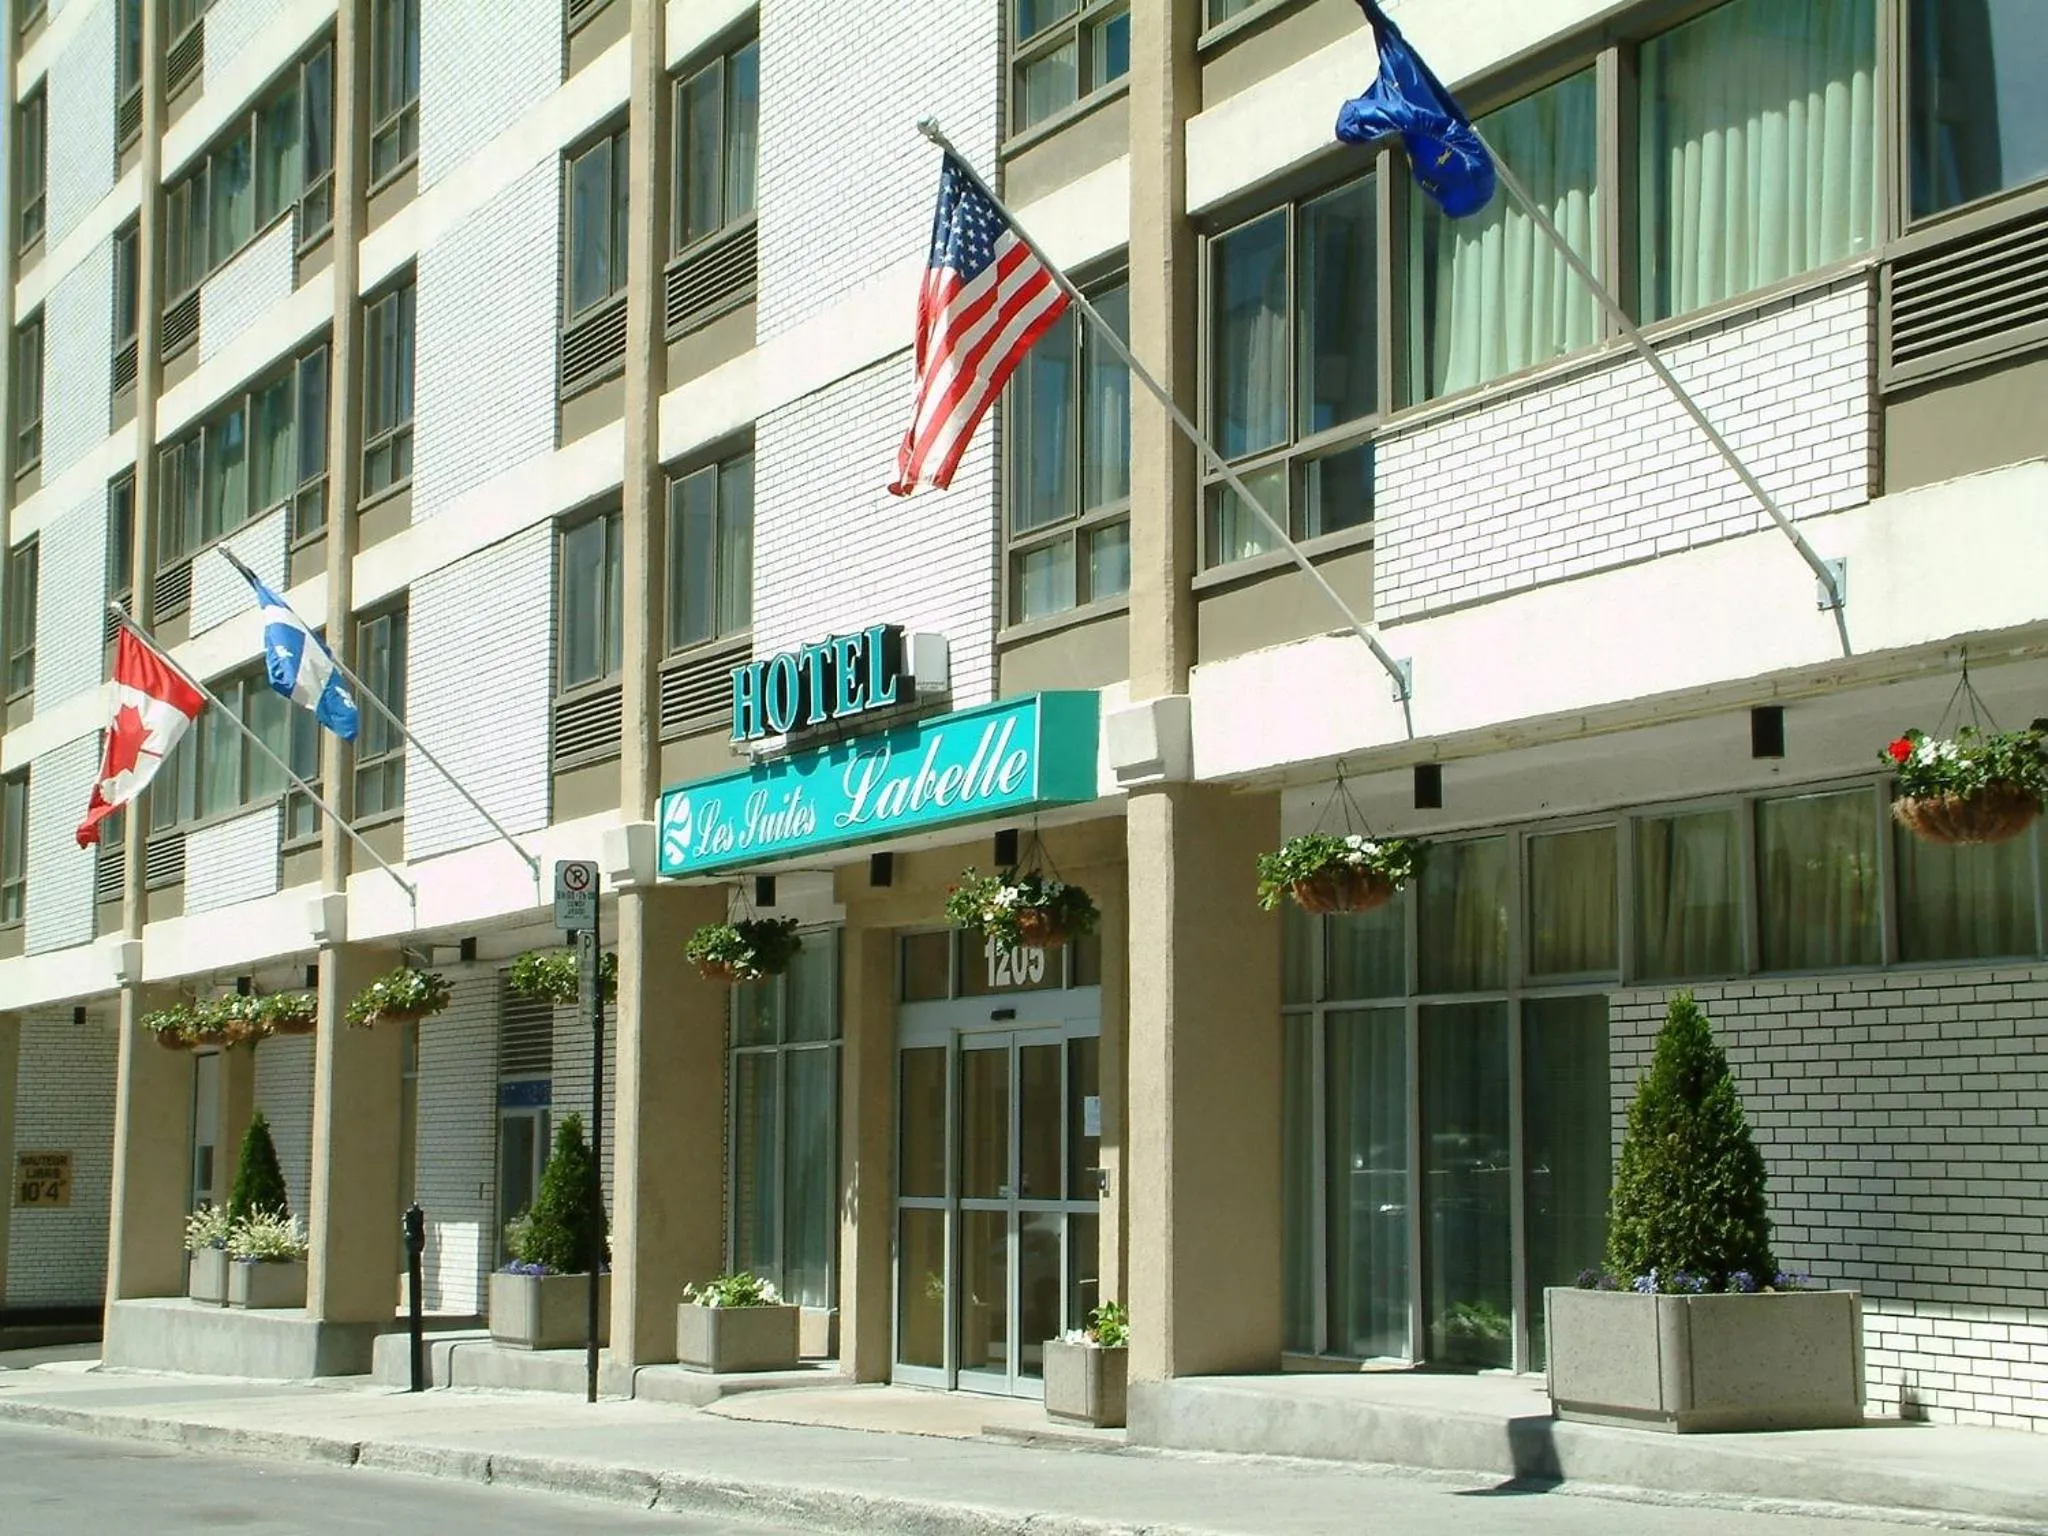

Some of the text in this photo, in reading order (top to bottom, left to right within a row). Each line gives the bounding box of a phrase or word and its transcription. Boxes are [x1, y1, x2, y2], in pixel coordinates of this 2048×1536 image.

[731, 624, 897, 742] HOTEL
[694, 716, 1029, 859] Les Suites Labelle
[984, 934, 1045, 988] 1205
